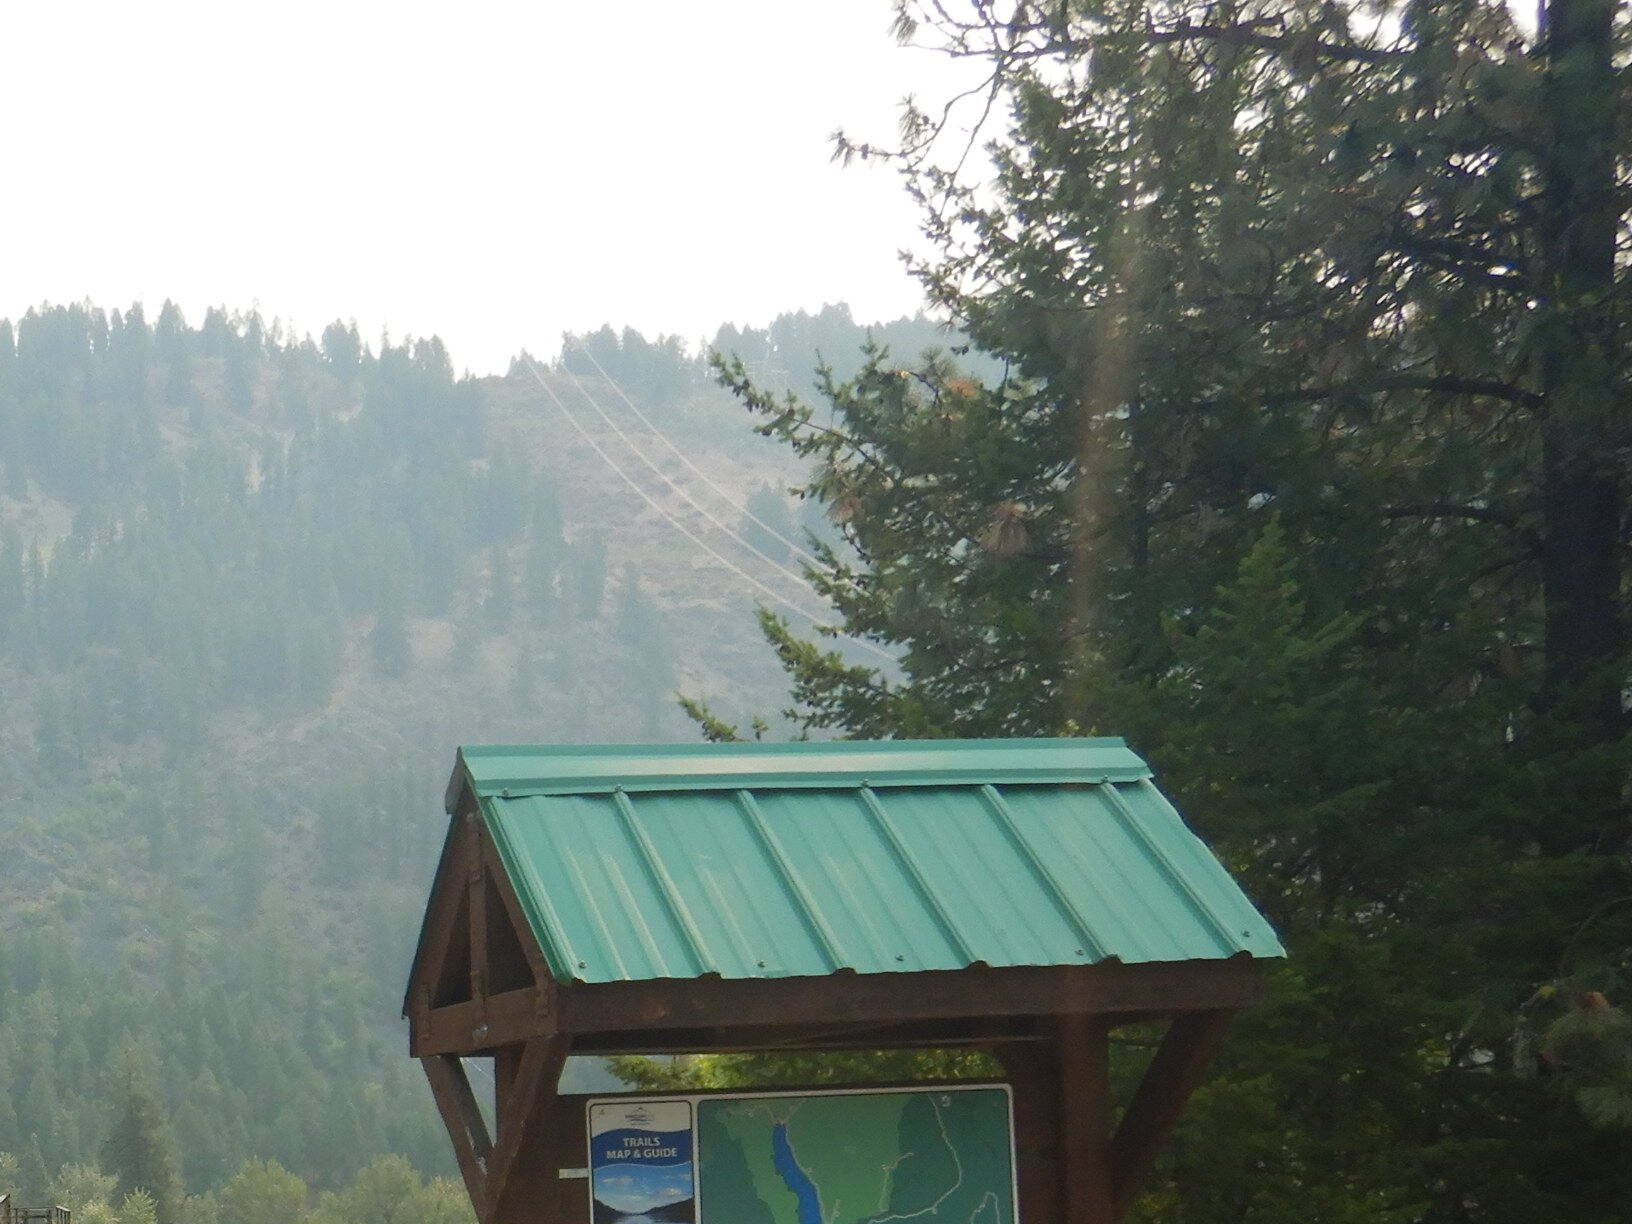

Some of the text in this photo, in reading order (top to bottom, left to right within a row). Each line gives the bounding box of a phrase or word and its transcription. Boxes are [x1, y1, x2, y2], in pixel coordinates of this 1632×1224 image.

[622, 1136, 661, 1147] TRAILS
[606, 1147, 678, 1159] MAP & GUIDE
